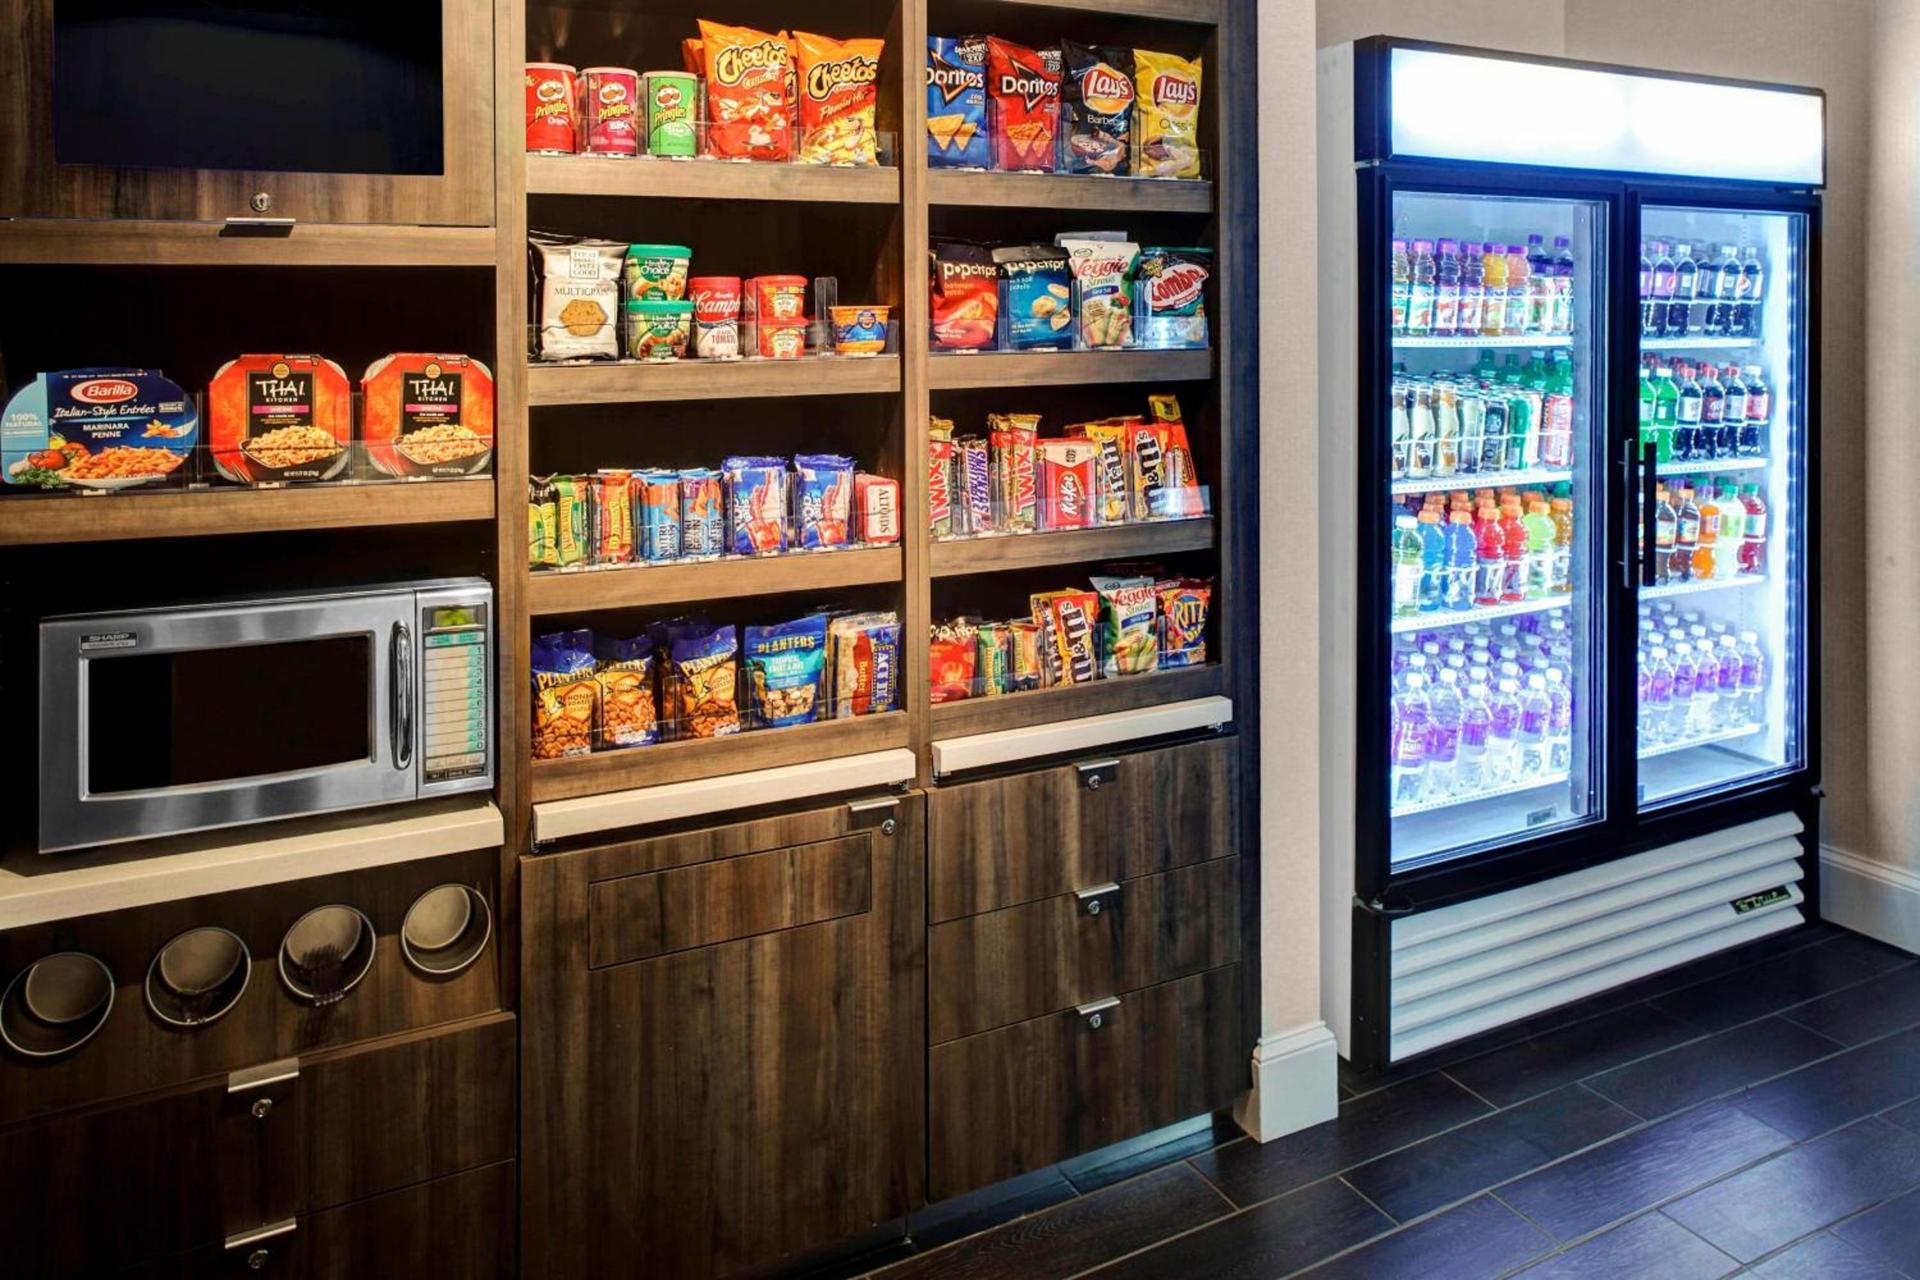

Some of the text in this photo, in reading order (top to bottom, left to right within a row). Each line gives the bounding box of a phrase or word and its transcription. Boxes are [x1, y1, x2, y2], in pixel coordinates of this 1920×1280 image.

[717, 40, 788, 85] Cheetos
[808, 56, 878, 100] Cheetos
[927, 67, 984, 88] Doritos
[1002, 76, 1059, 96] Doritos
[1087, 70, 1129, 100] Lay's
[1157, 77, 1196, 105] Lay's
[535, 101, 568, 119] Pringles
[599, 103, 631, 119] Pringles
[655, 107, 686, 122] Pringles
[1070, 256, 1129, 277] Veggie
[87, 384, 133, 397] Barilla
[256, 380, 305, 398] THAI
[409, 380, 454, 397] THAI
[54, 405, 117, 421] Italian-Style
[83, 423, 130, 432] MARINARA
[92, 431, 122, 439] PENNE
[1015, 448, 1036, 515] TWIX
[879, 488, 890, 533] ALTOIDS
[1107, 586, 1157, 608] Veggie
[1174, 601, 1205, 629] RITZ
[89, 633, 130, 642] SHARP
[858, 660, 869, 693] Butter
[877, 653, 889, 680] ACT
[537, 667, 595, 691] PLANTERS
